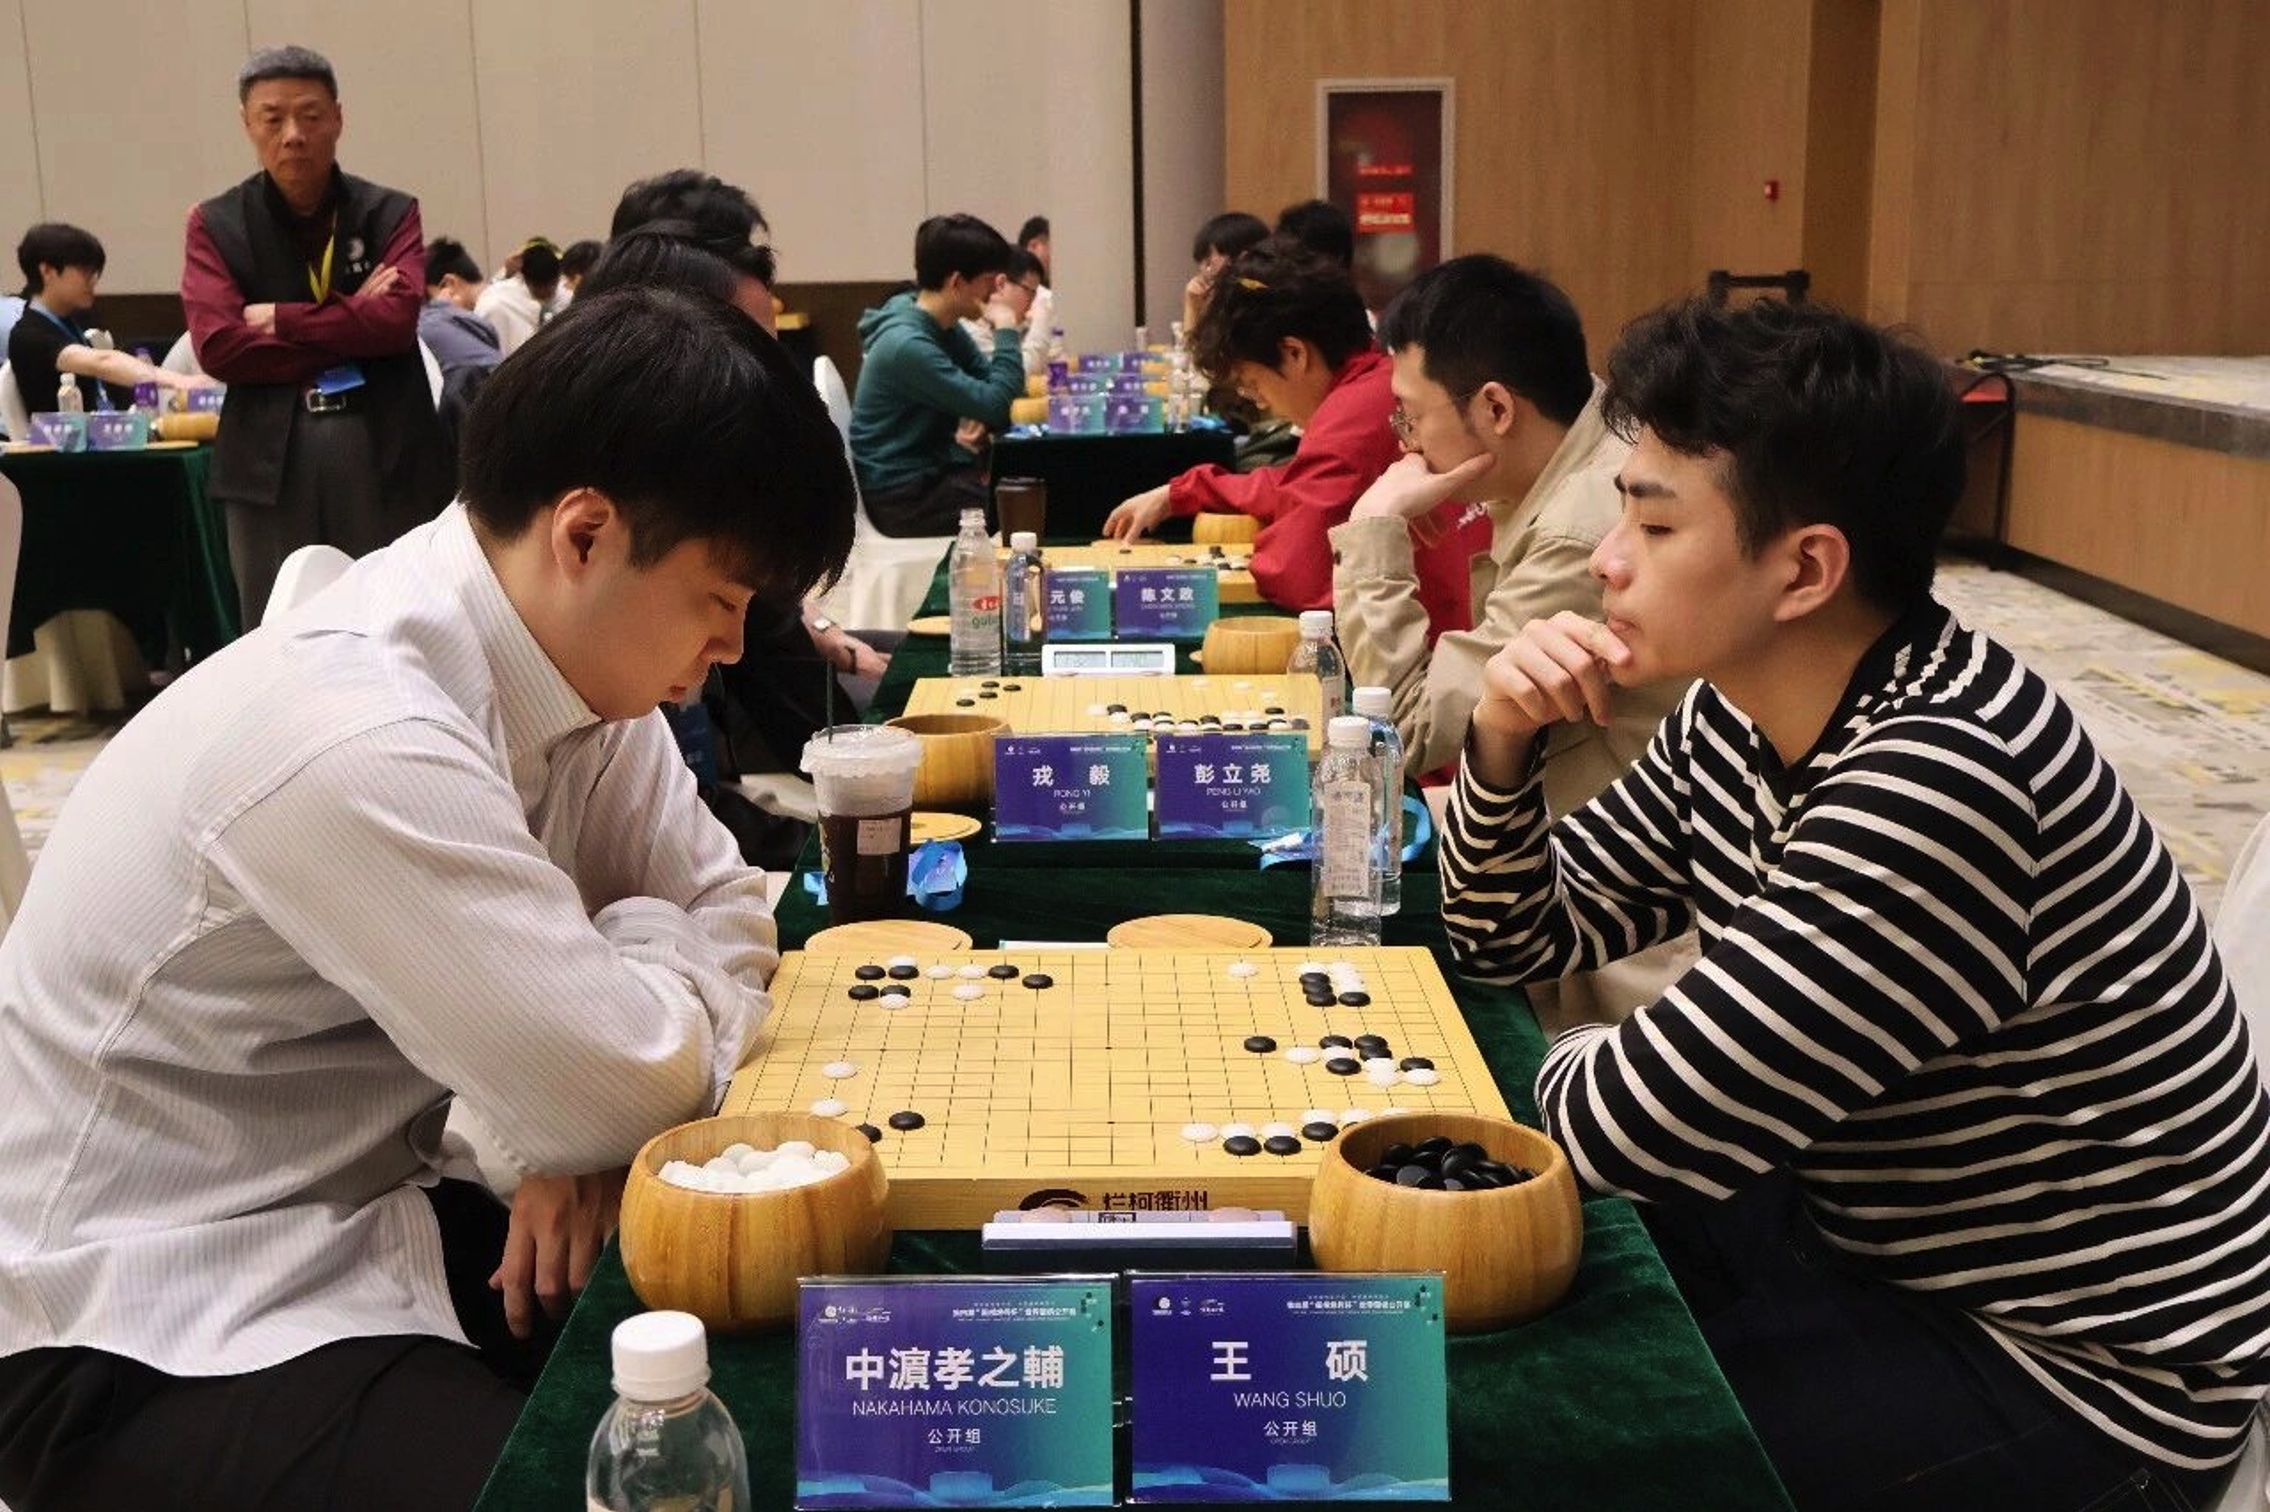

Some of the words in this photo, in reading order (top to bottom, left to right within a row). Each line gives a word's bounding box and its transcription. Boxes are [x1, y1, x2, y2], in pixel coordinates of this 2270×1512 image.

[1194, 763, 1272, 784] 彭立尧
[1103, 1190, 1208, 1211] 烂柯衢州
[852, 1398, 953, 1417] NAKAHAMA
[957, 1397, 1057, 1415] KONOSUKE
[1234, 1391, 1290, 1408] WANG
[1295, 1391, 1346, 1407] SHUO
[927, 1428, 981, 1445] 公开组
[1263, 1420, 1318, 1437] 公开组
